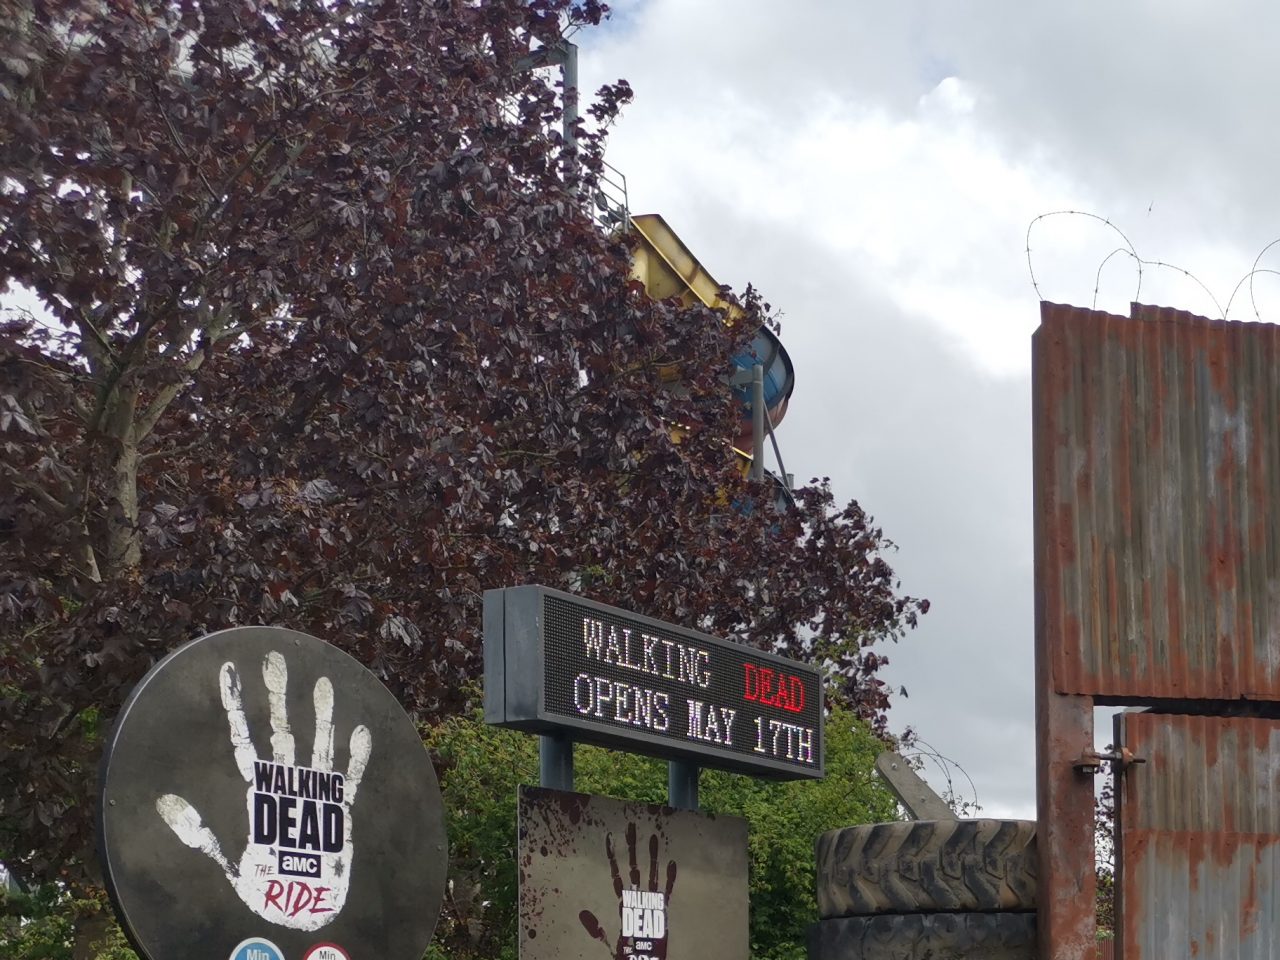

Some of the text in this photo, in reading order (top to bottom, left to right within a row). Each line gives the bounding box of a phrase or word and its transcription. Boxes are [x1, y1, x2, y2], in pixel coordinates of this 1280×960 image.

[583, 618, 805, 713] WALKING DEAD
[574, 673, 813, 763] OPENS MAY 17TH
[254, 761, 344, 803] WALKING
[253, 792, 344, 853] DEAD
[254, 863, 275, 878] THE
[265, 879, 334, 917] RIDE
[622, 890, 664, 910] WALKING
[622, 907, 665, 938] DEAD
[319, 950, 336, 960] Min
